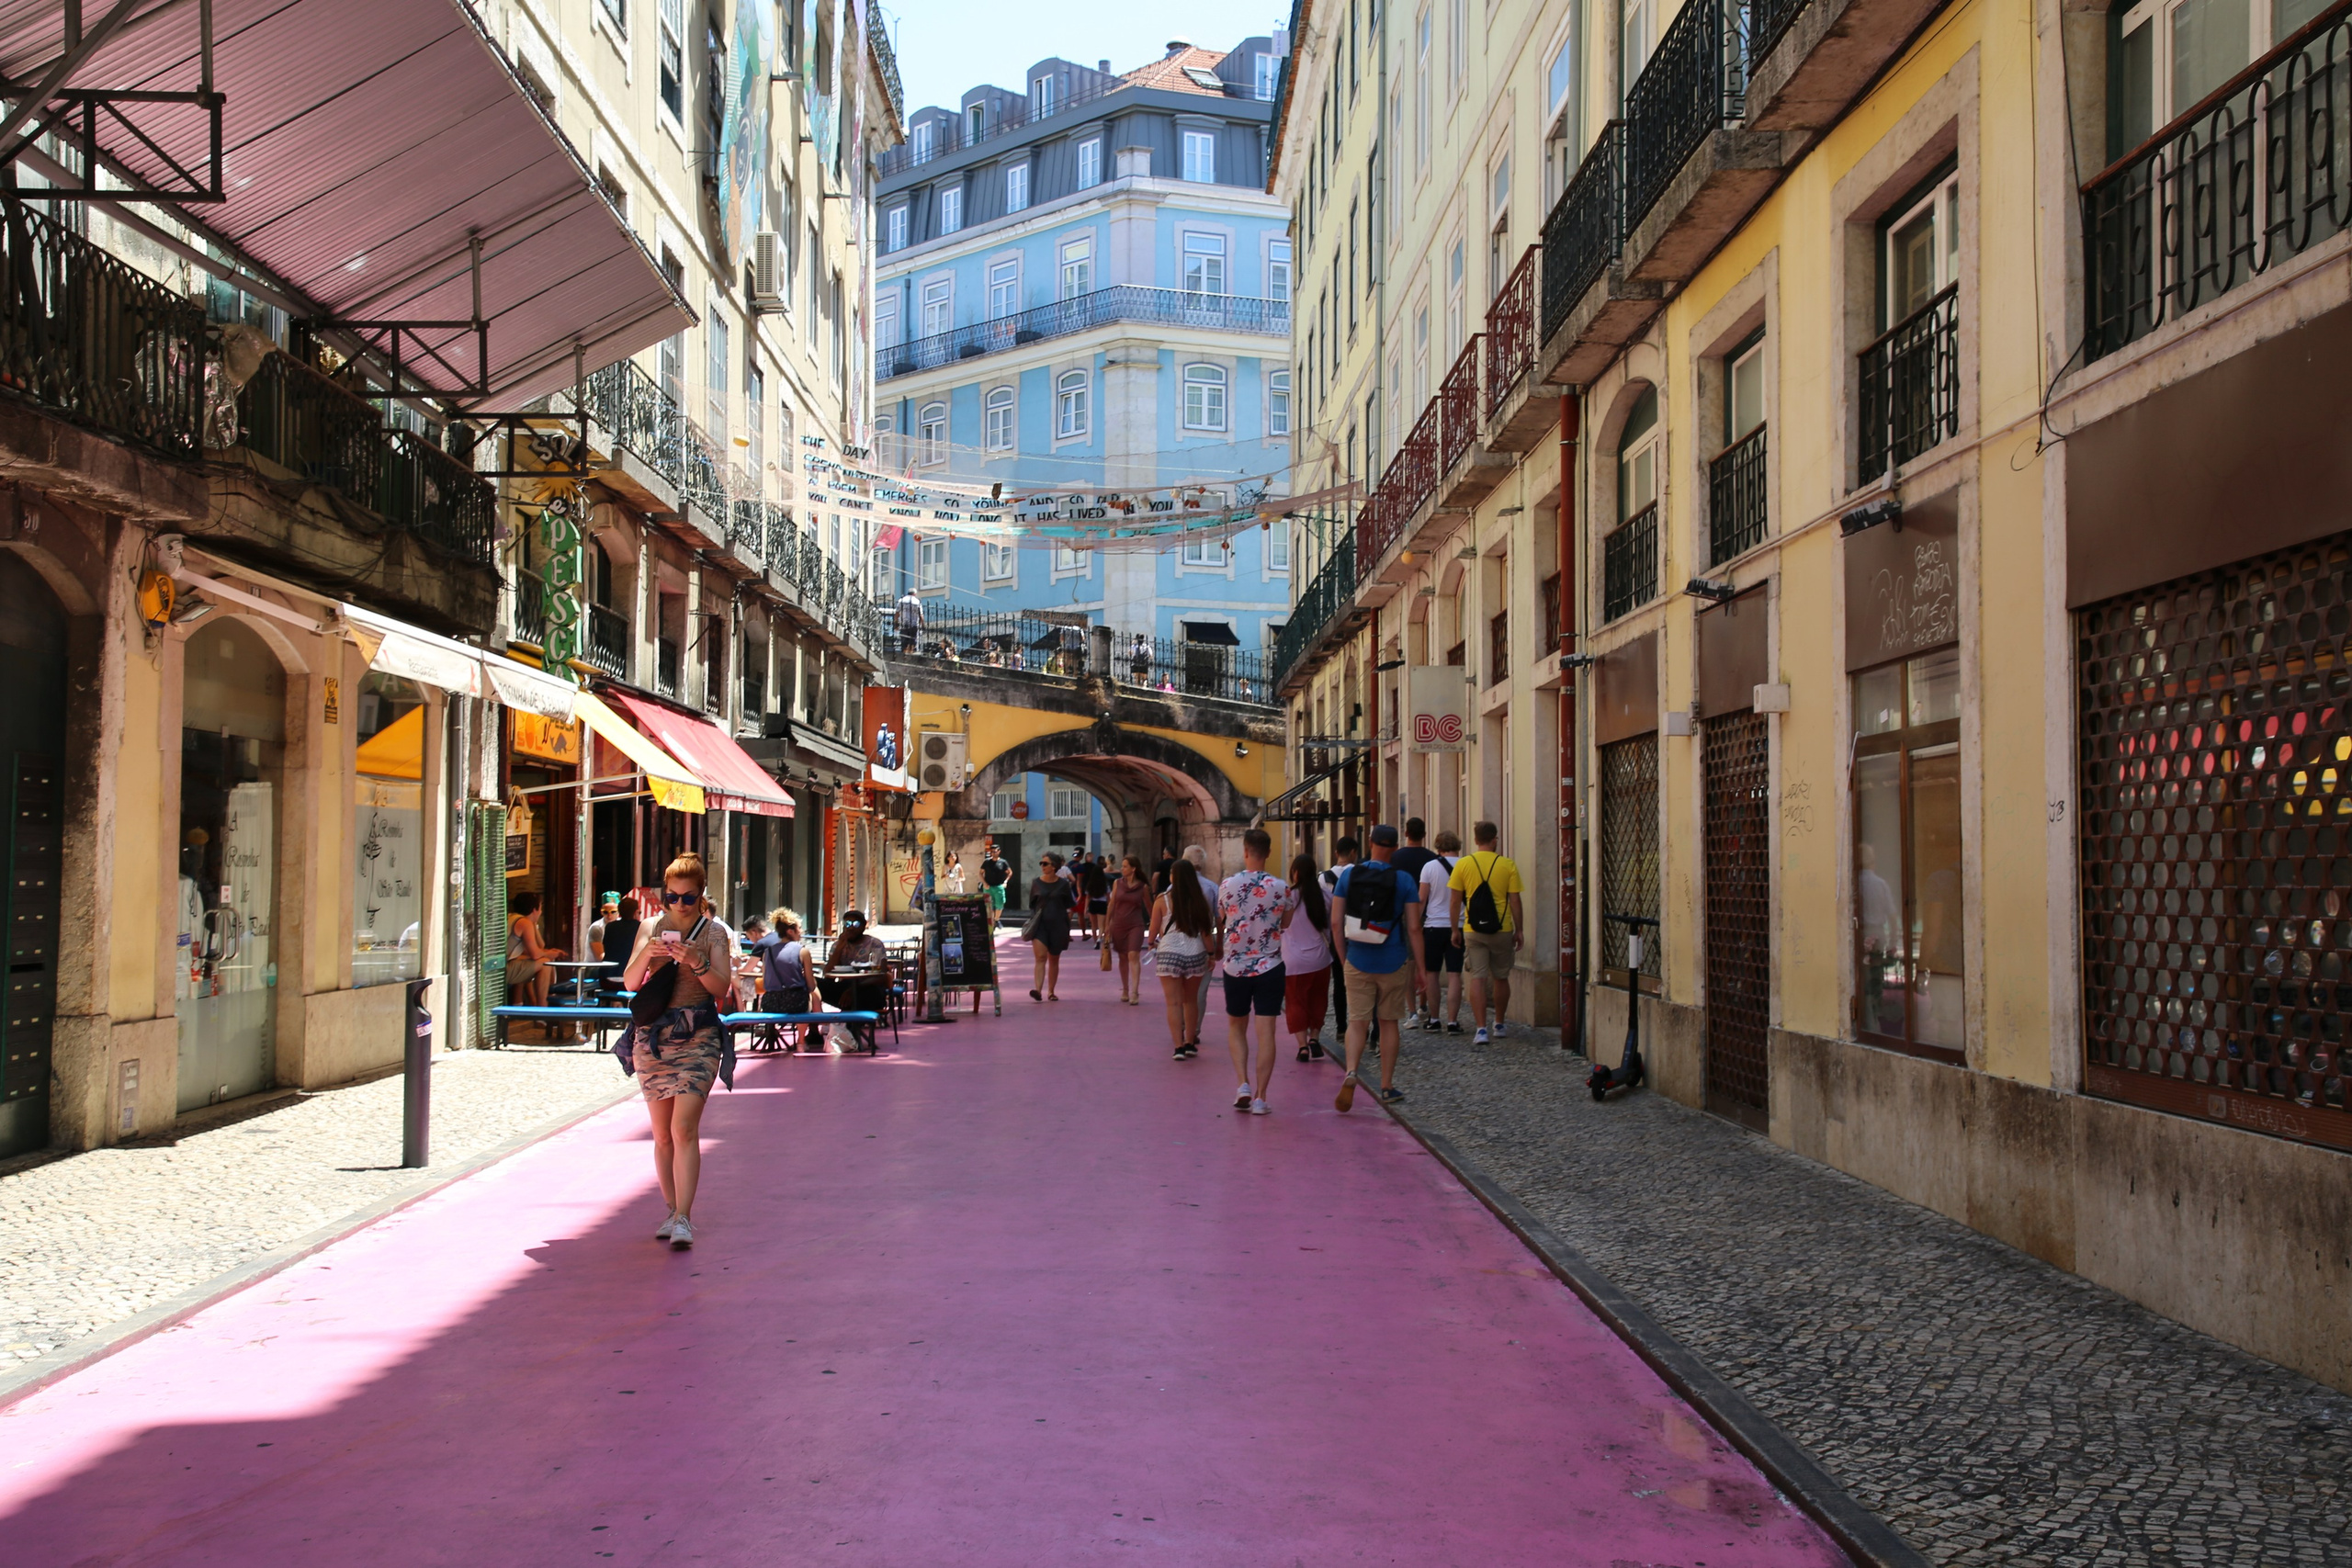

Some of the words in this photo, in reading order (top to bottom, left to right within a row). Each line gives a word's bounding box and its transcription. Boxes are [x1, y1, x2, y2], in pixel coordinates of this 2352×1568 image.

[842, 445, 869, 459] DAY
[828, 481, 856, 494] POEM
[875, 489, 928, 503] EMERGES
[1029, 497, 1054, 506] AND
[808, 491, 827, 504] YOU
[839, 498, 872, 510] CAN'T
[889, 508, 921, 517] KNOW
[933, 511, 960, 521] HOW
[1014, 513, 1027, 523] IT
[1037, 511, 1060, 521] HAS
[1069, 508, 1106, 519] LIVED
[1149, 502, 1174, 512] YOU
[1415, 714, 1463, 742] BC
